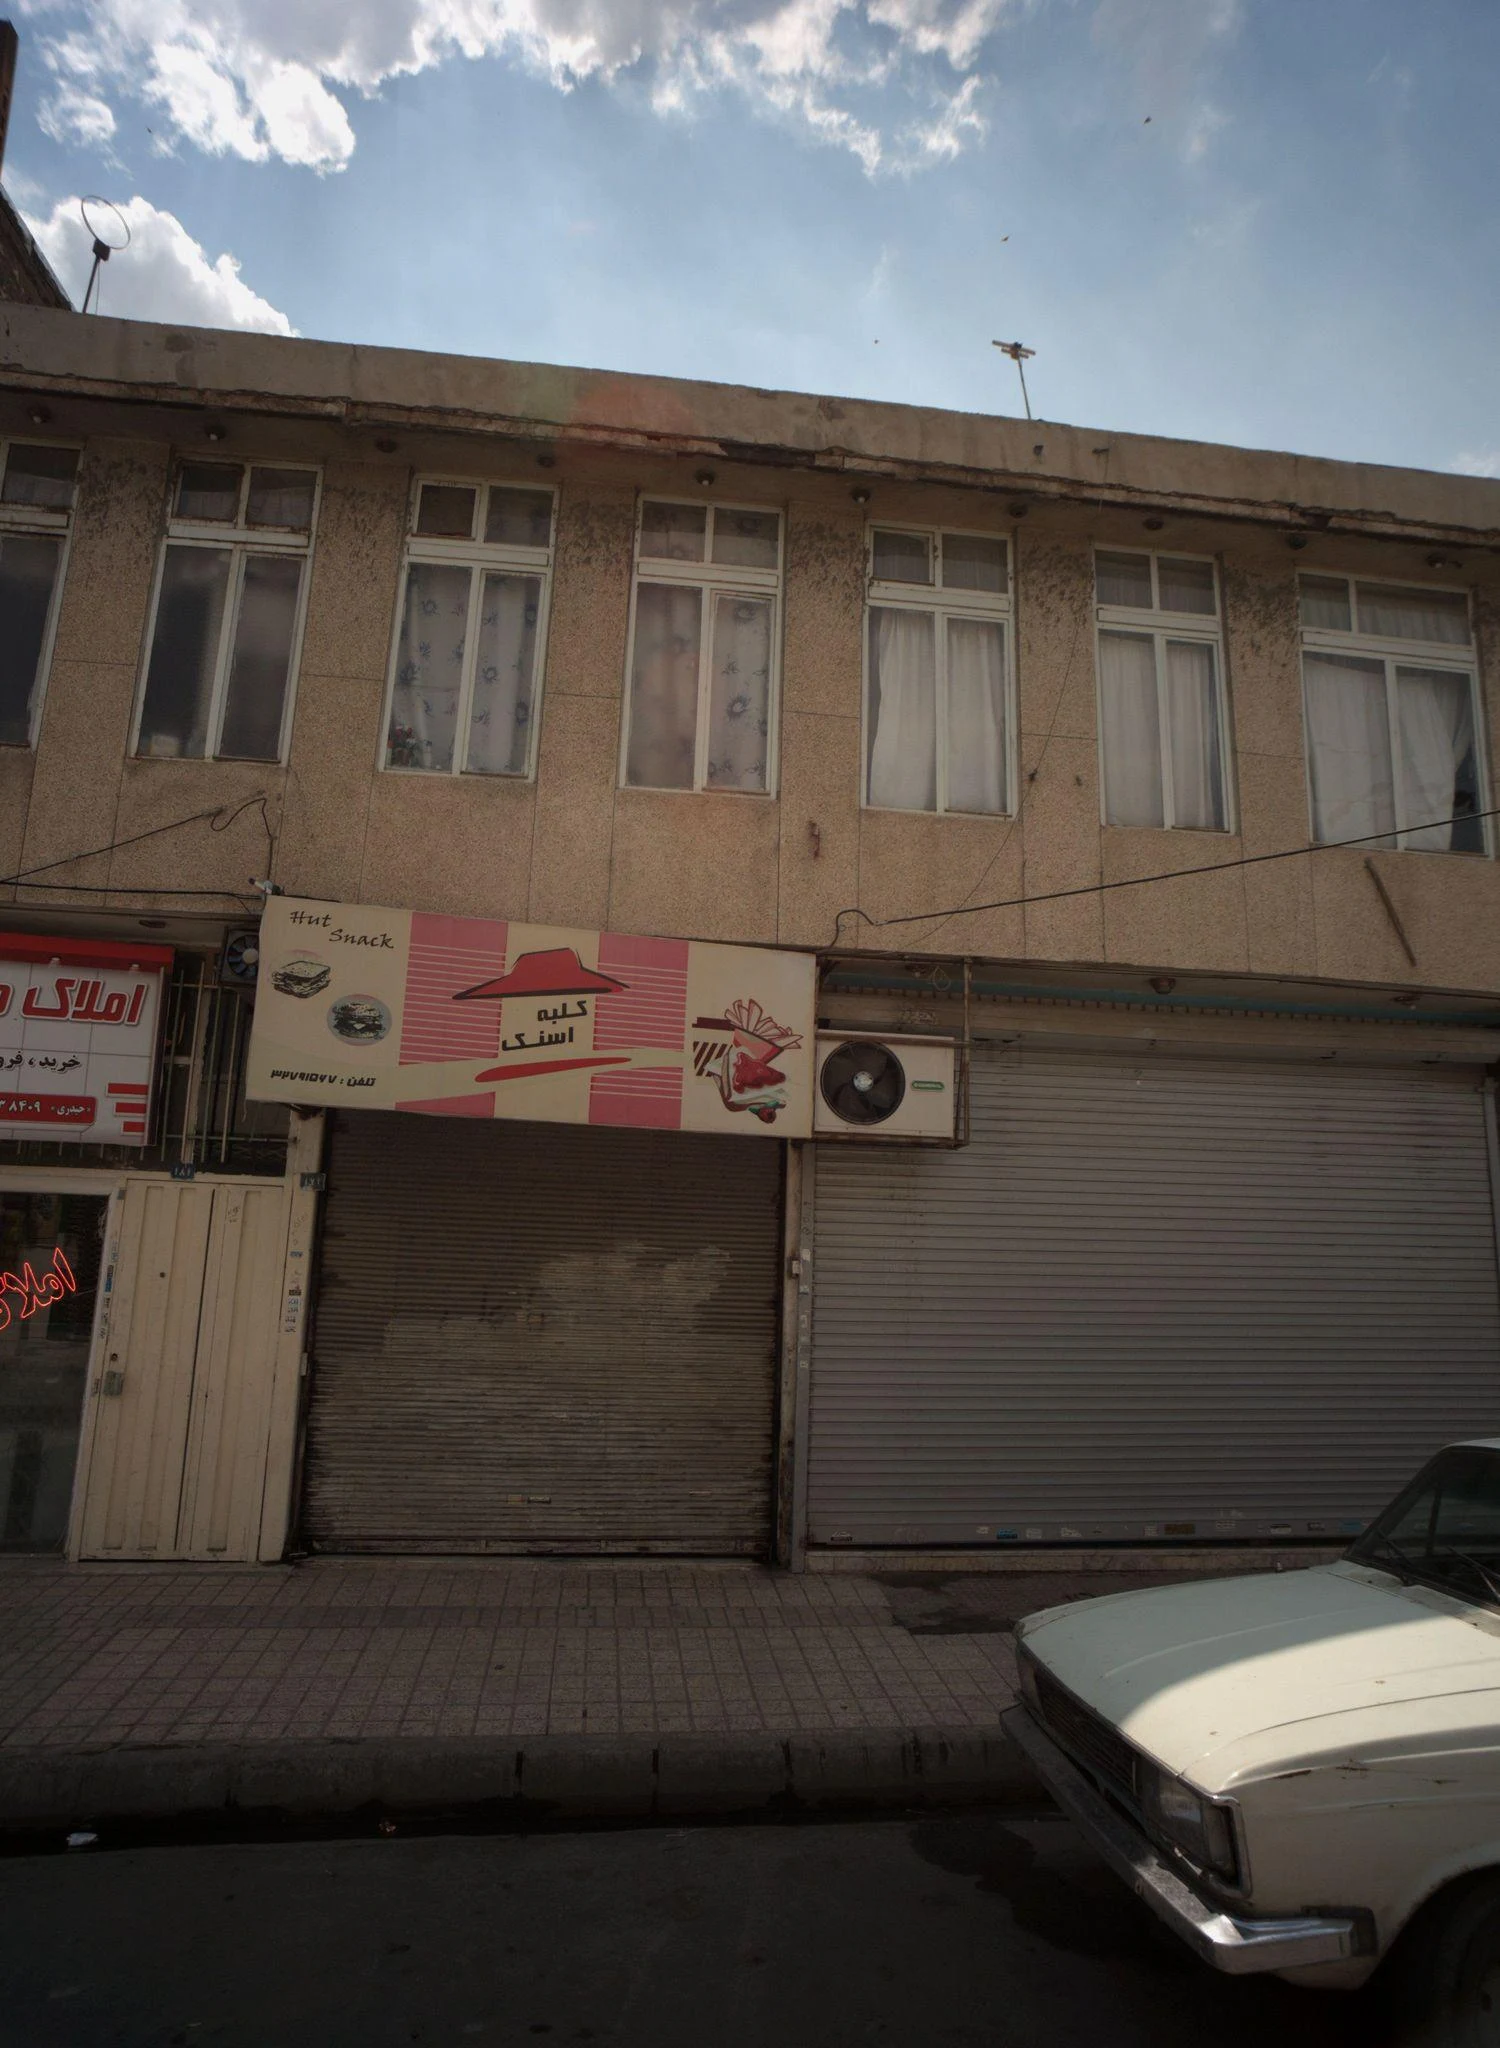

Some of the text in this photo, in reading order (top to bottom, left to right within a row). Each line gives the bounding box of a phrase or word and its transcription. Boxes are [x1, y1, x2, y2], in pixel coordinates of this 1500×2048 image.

[289, 910, 332, 928] Hut
[328, 928, 395, 949] Snack
[21, 977, 147, 1025] املاک
[537, 1000, 588, 1024] کلبه
[501, 1026, 574, 1051] اسنک
